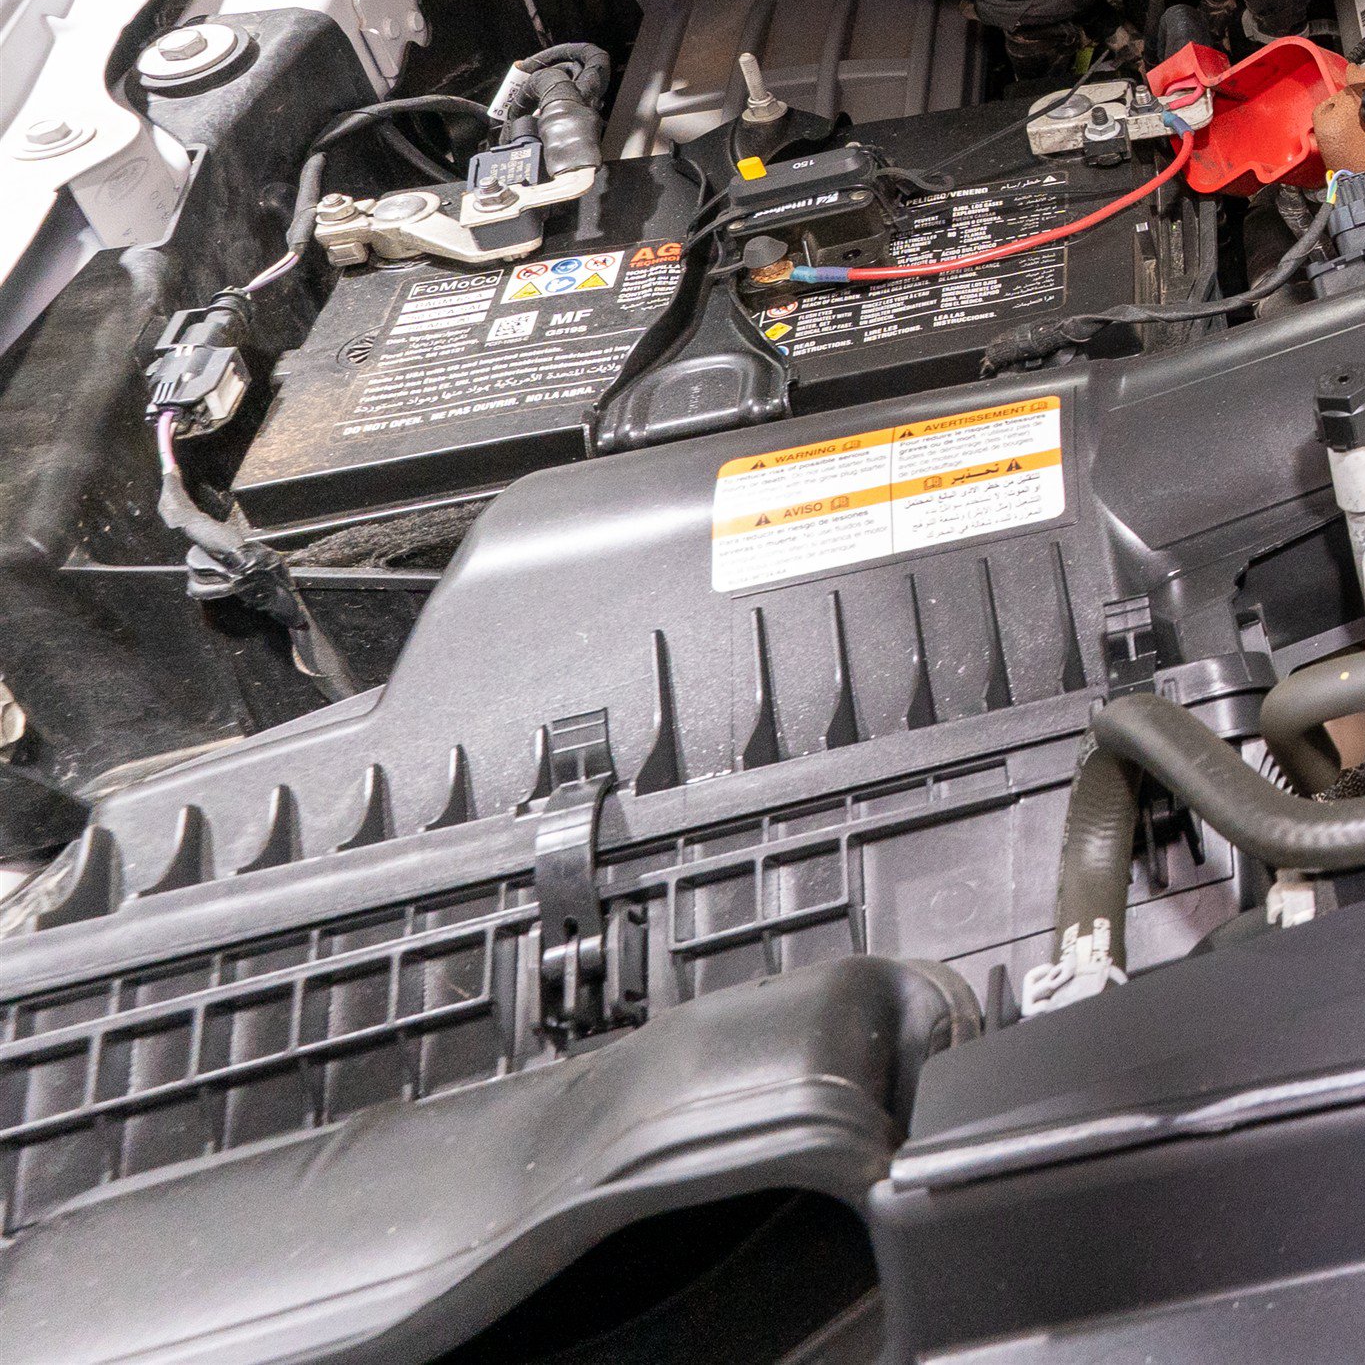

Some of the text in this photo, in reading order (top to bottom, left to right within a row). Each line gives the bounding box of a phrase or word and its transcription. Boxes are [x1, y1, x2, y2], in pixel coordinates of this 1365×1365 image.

[792, 159, 815, 169] 150
[411, 271, 500, 297] FoMoCo
[548, 307, 594, 326] MF
[932, 310, 966, 321] LEA LAS
[932, 310, 998, 327] INSTRUCCIONES.
[862, 324, 924, 342] INSTRUCTIONS.
[863, 324, 899, 336] LIRE LES
[792, 340, 816, 350] READ
[792, 338, 854, 356] INSTRUCTIONS.
[366, 375, 394, 385] Made
[404, 369, 426, 379] USA
[341, 383, 598, 435] DO NOT OPEN. NE PAS OUVRIR. NO LA ABRA.
[923, 403, 1026, 434] AVERTISSEMENT
[774, 444, 836, 464] WARNING
[783, 501, 823, 519] AVISO
[832, 508, 868, 523] lesiones
